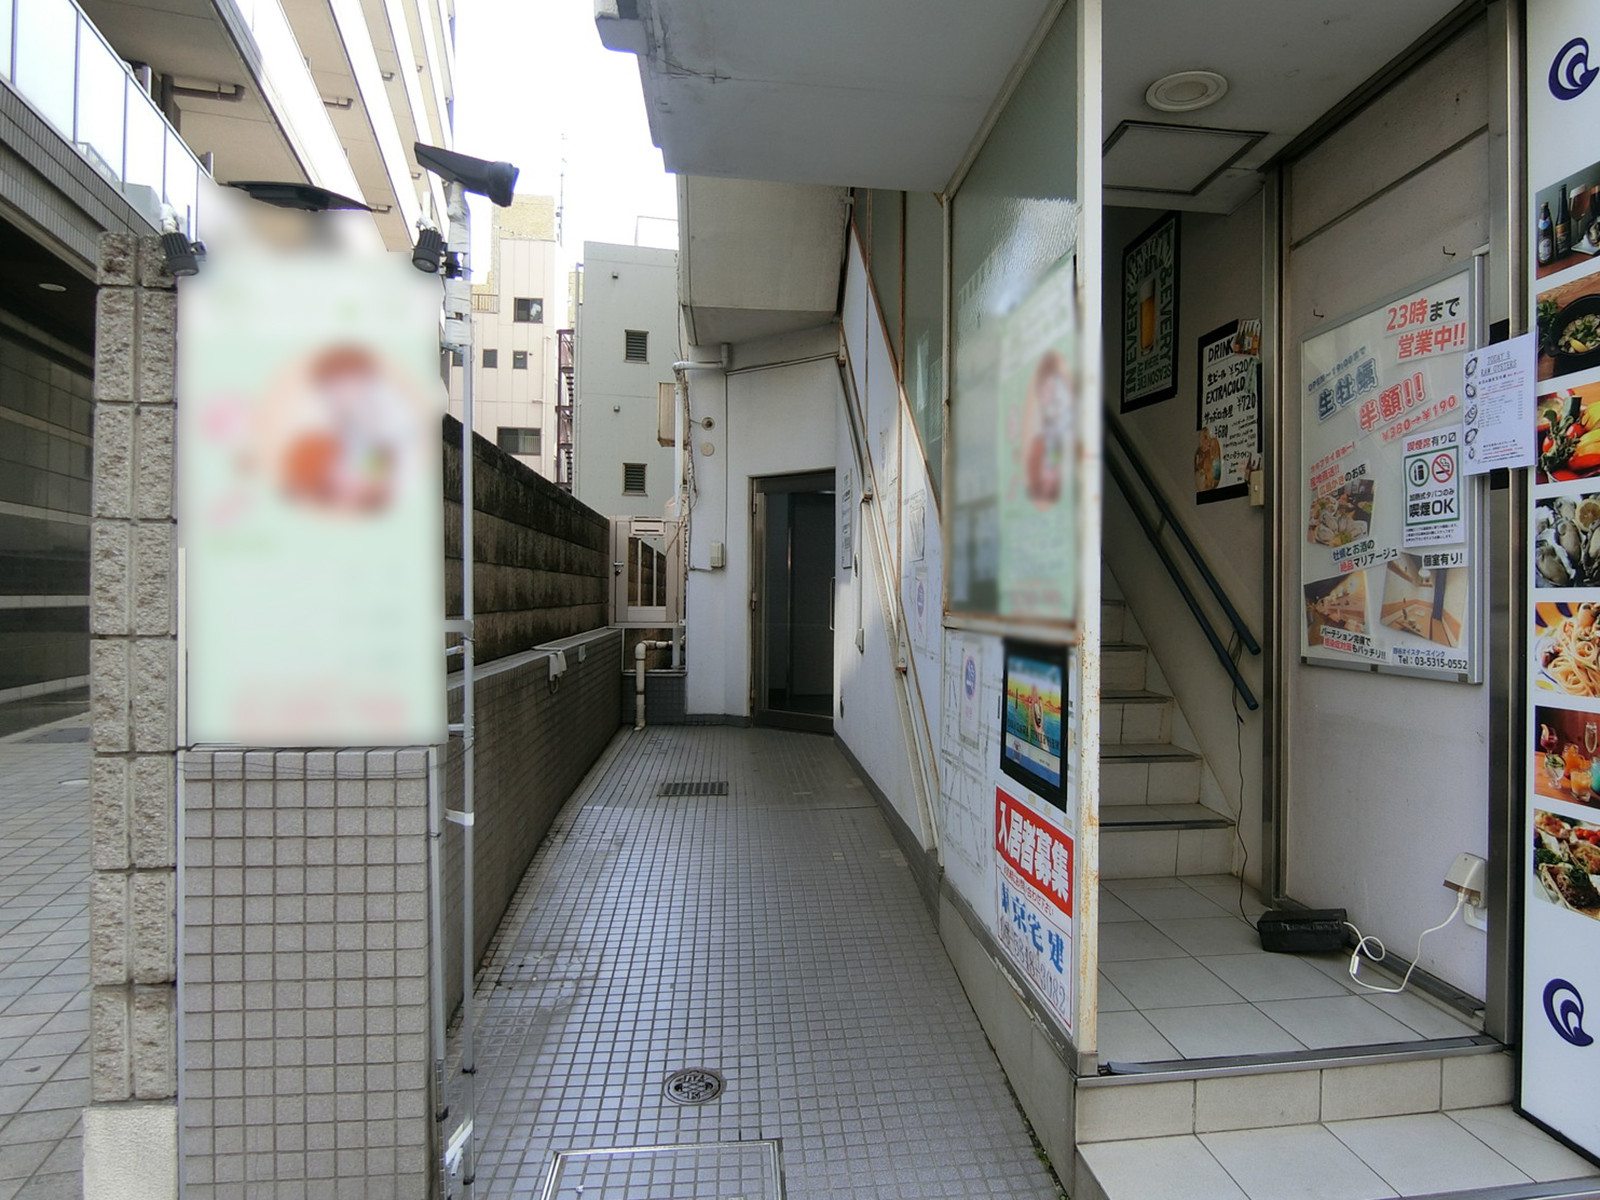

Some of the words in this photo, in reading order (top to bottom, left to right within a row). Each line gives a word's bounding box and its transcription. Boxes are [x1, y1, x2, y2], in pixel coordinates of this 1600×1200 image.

[1126, 291, 1137, 364] EVERY
[1160, 284, 1173, 362] EVERY
[1385, 297, 1461, 331] 23時まで
[1398, 322, 1467, 359] 営業中!!
[1318, 357, 1378, 420] 生牡蠣
[1359, 371, 1426, 432] 半額!!
[1409, 498, 1455, 518] 喫煙OK
[1423, 552, 1463, 568] 個室有り!
[1414, 657, 1468, 670] 03-5315-0552
[998, 800, 1069, 903] 入居者募集
[1001, 881, 1065, 974] 東京宅建
